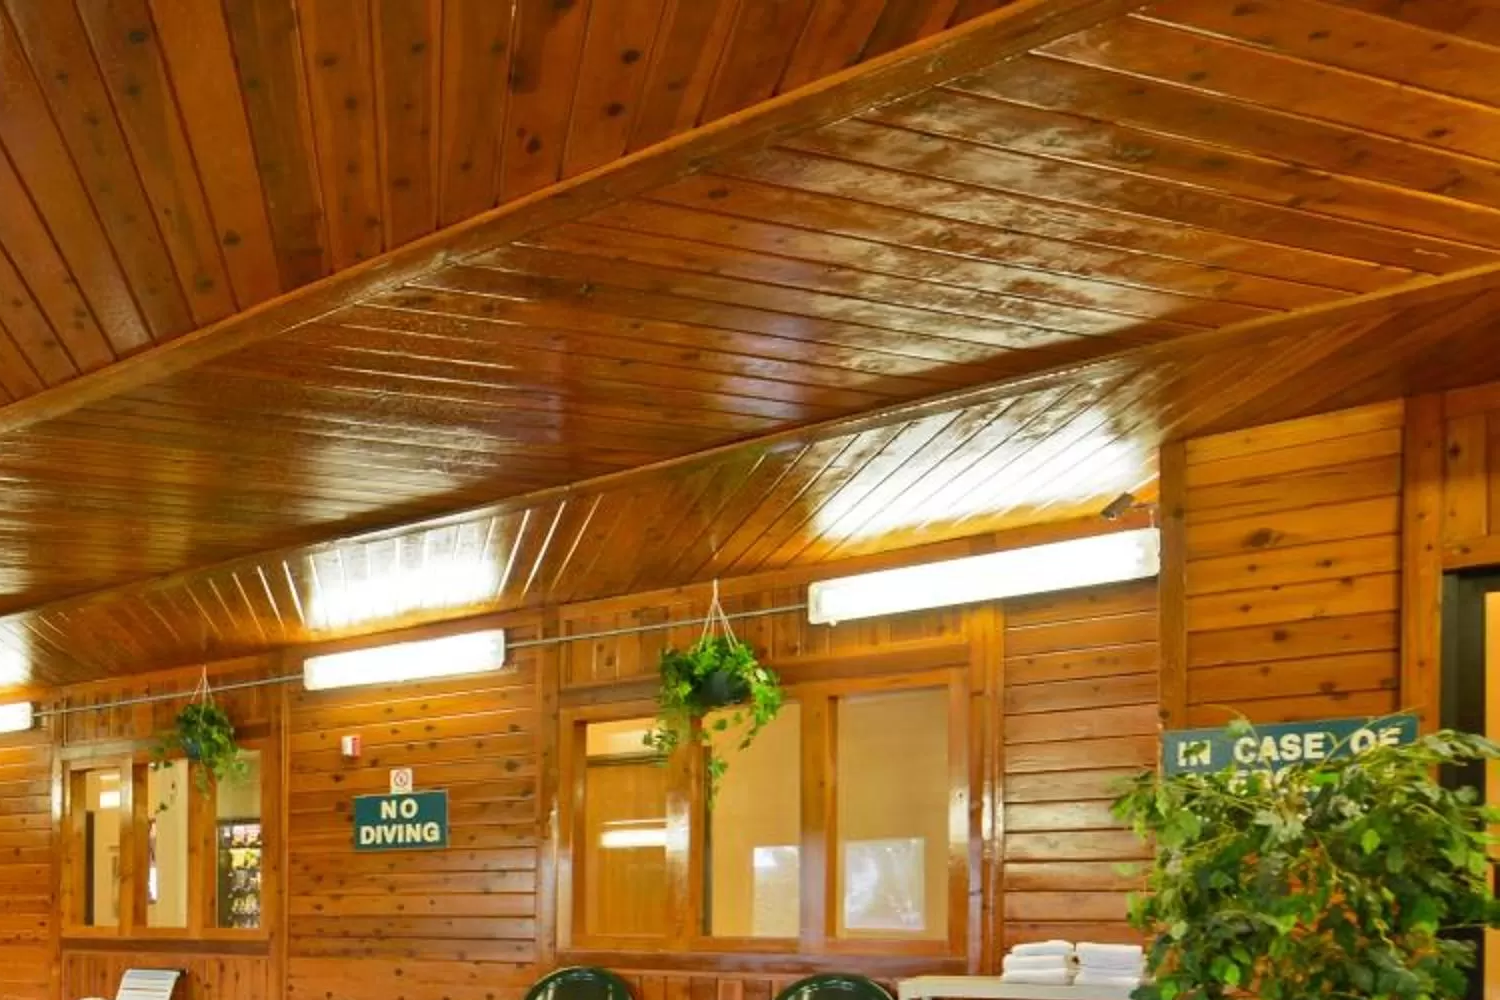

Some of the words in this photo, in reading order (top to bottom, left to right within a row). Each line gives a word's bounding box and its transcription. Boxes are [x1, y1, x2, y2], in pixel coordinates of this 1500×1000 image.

[1177, 740, 1211, 767] IN
[1233, 732, 1325, 764] CASE
[381, 798, 418, 819] NO
[360, 822, 440, 845] DIVING
